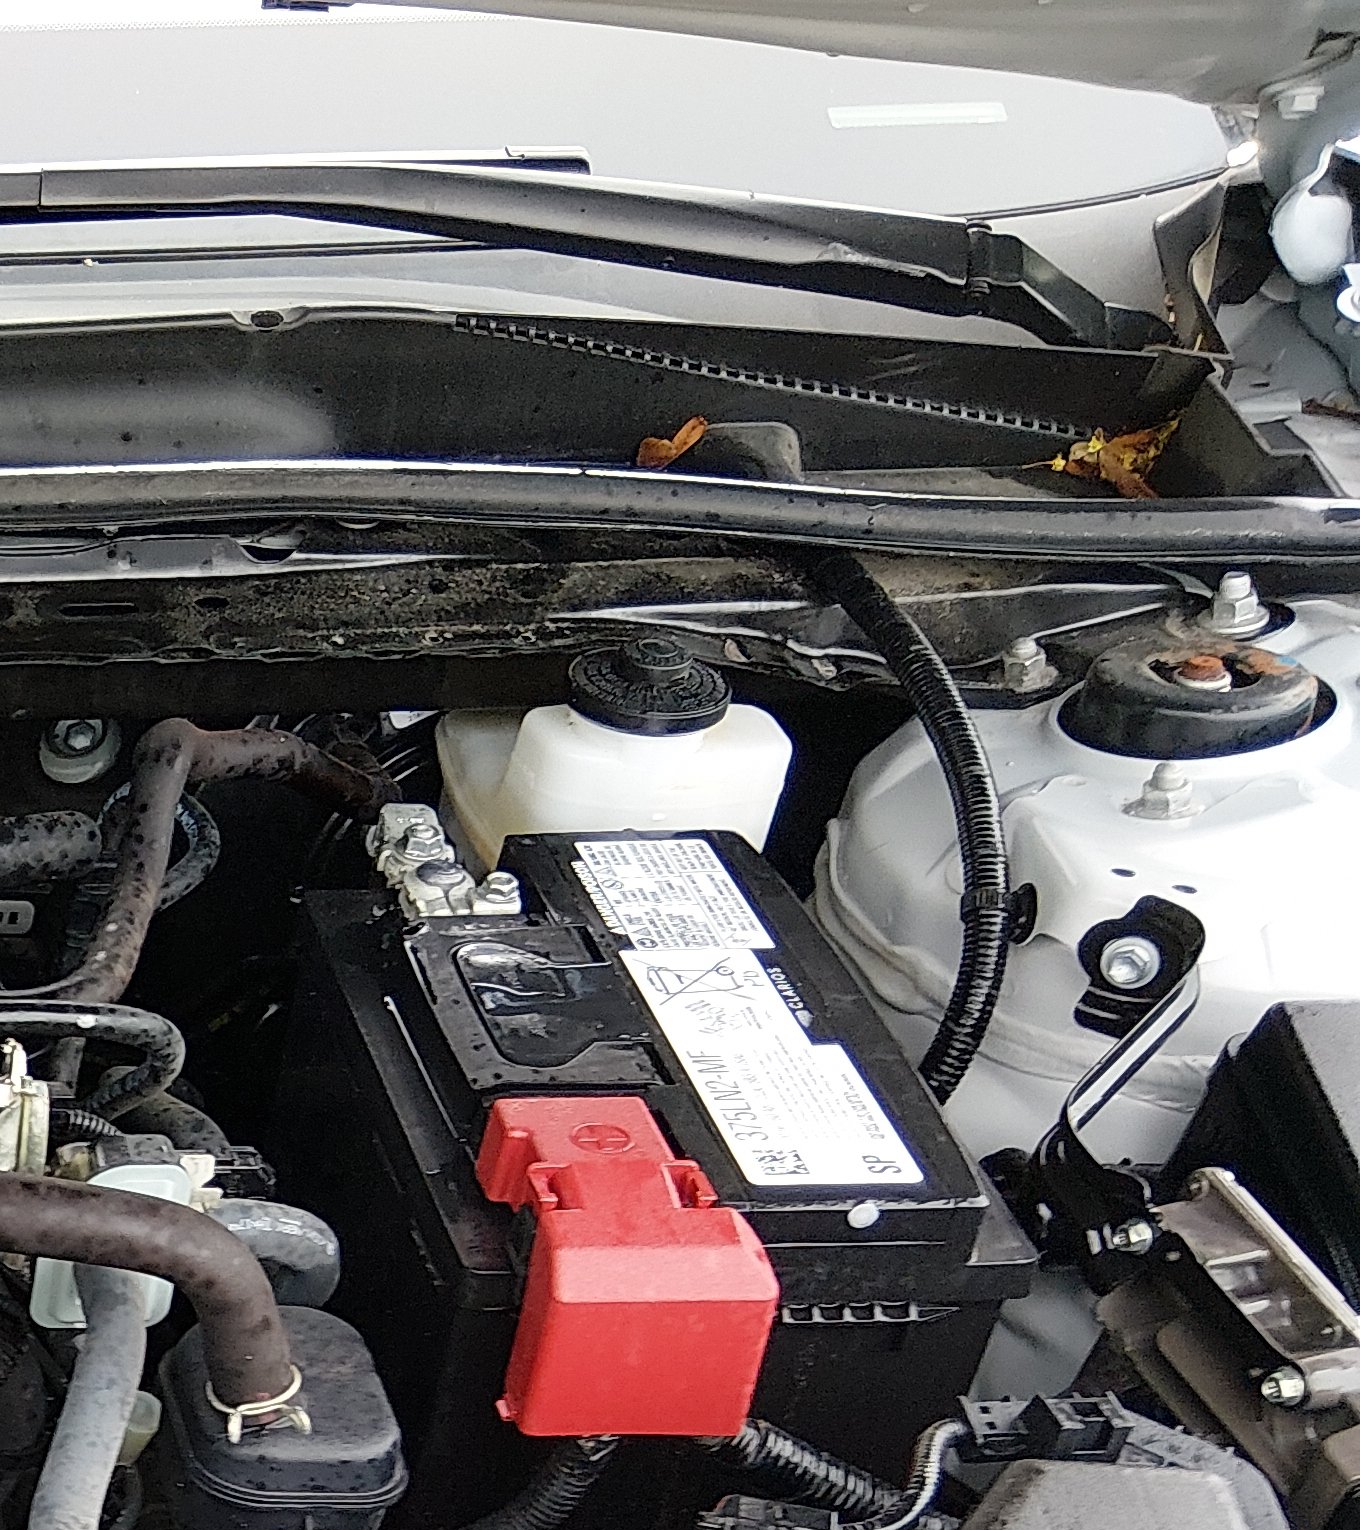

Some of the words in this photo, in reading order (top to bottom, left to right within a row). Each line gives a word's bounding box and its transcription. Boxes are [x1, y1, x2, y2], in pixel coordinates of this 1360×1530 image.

[766, 967, 805, 1009] CLARIOS
[686, 1050, 770, 1141] 375LN2-MF
[861, 1154, 903, 1174] SP
